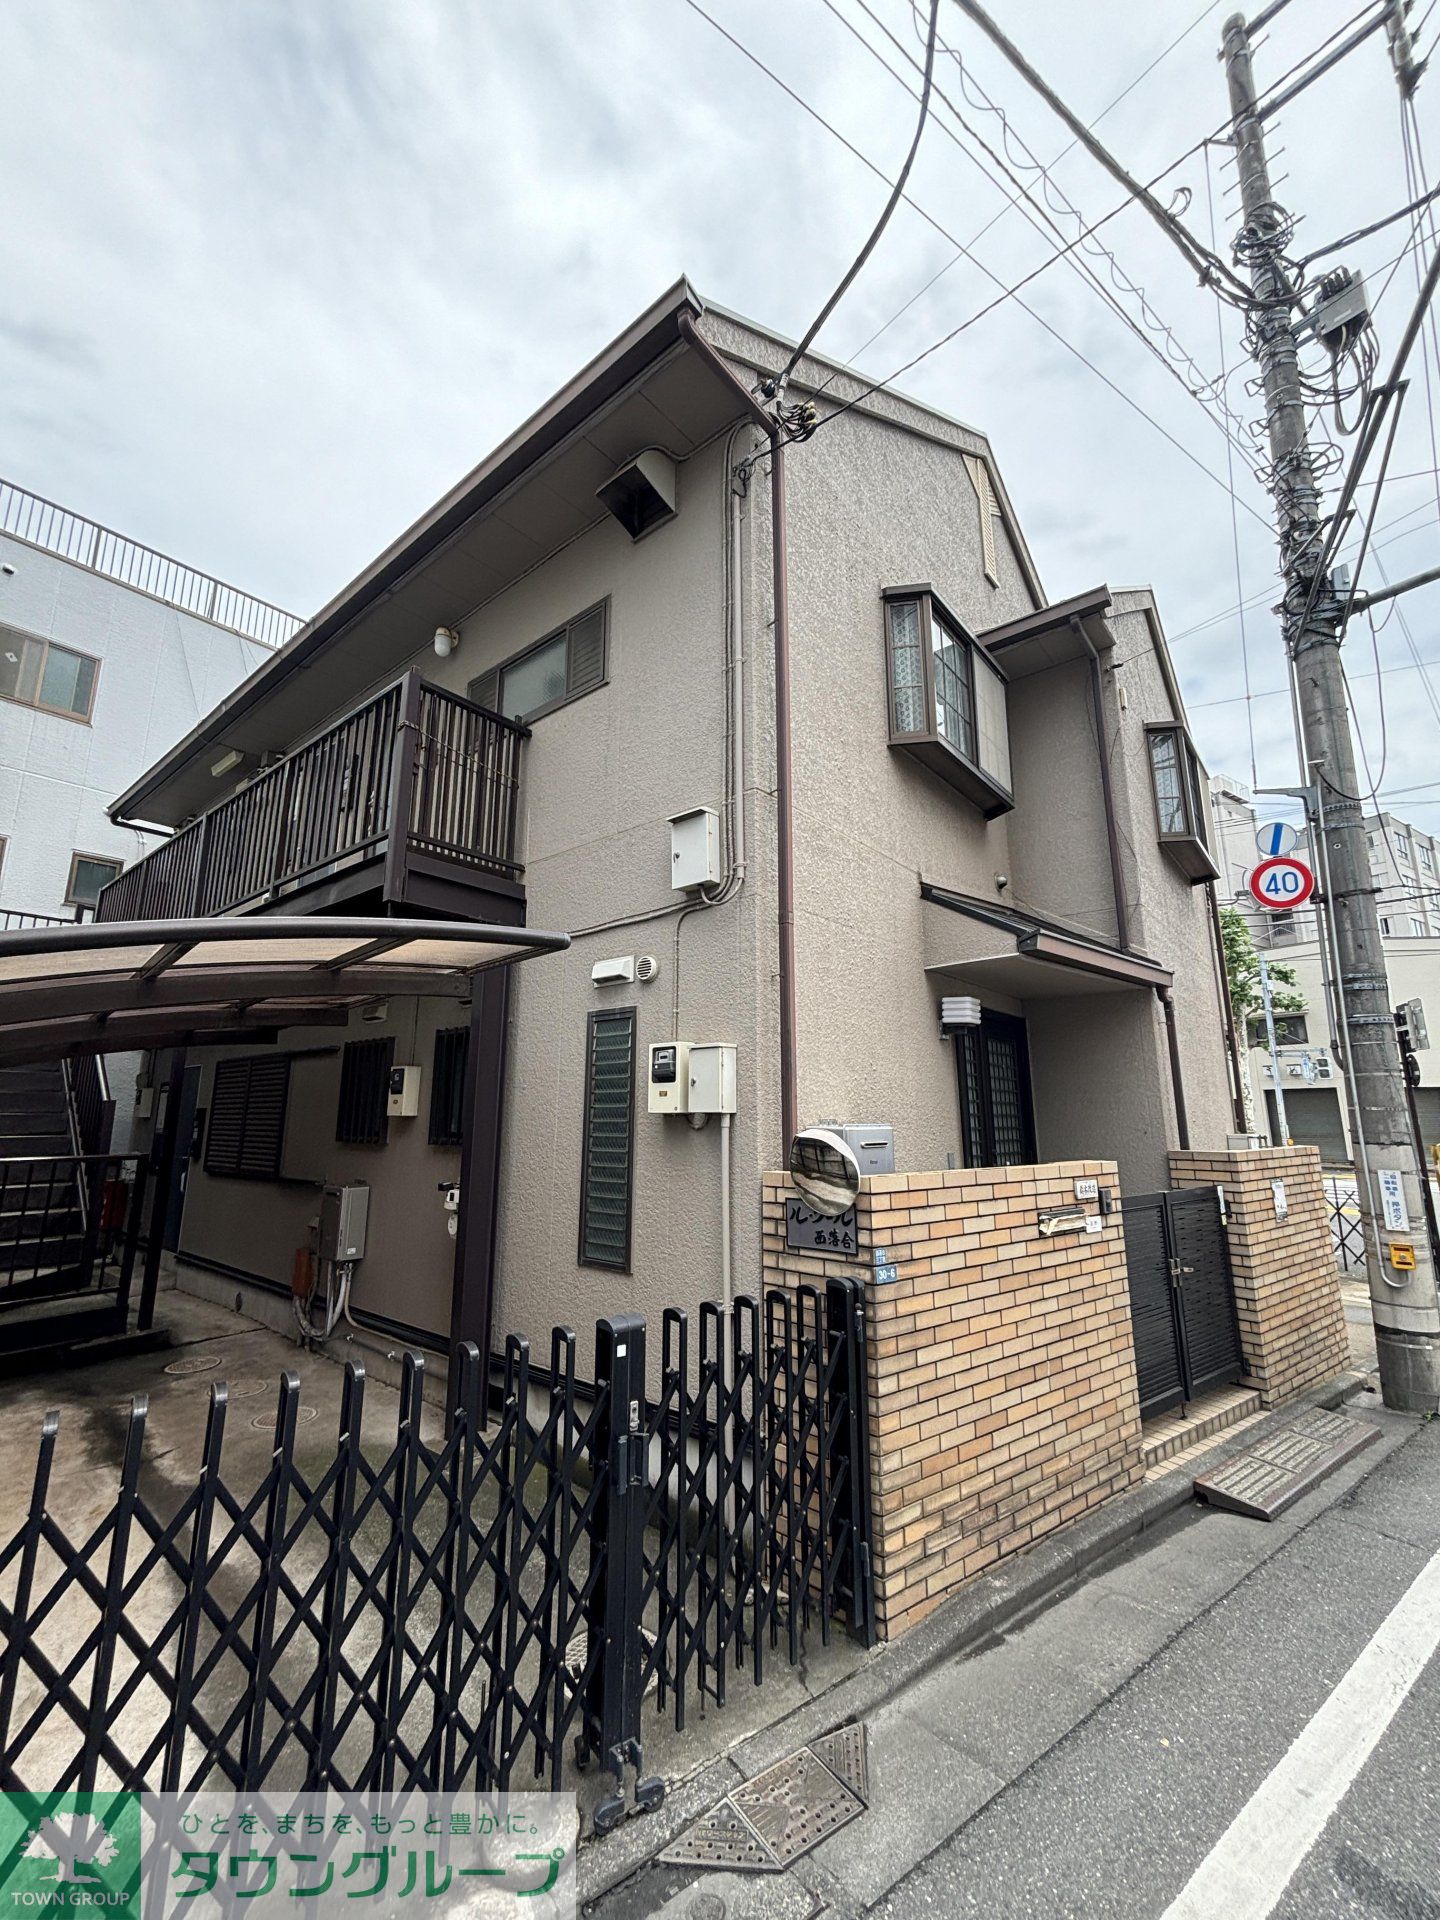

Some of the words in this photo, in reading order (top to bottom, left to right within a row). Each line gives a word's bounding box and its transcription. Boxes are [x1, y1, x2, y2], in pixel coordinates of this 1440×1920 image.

[1265, 871, 1299, 895] 40
[815, 1228, 854, 1248] 西落合
[878, 1268, 896, 1280] 30-6
